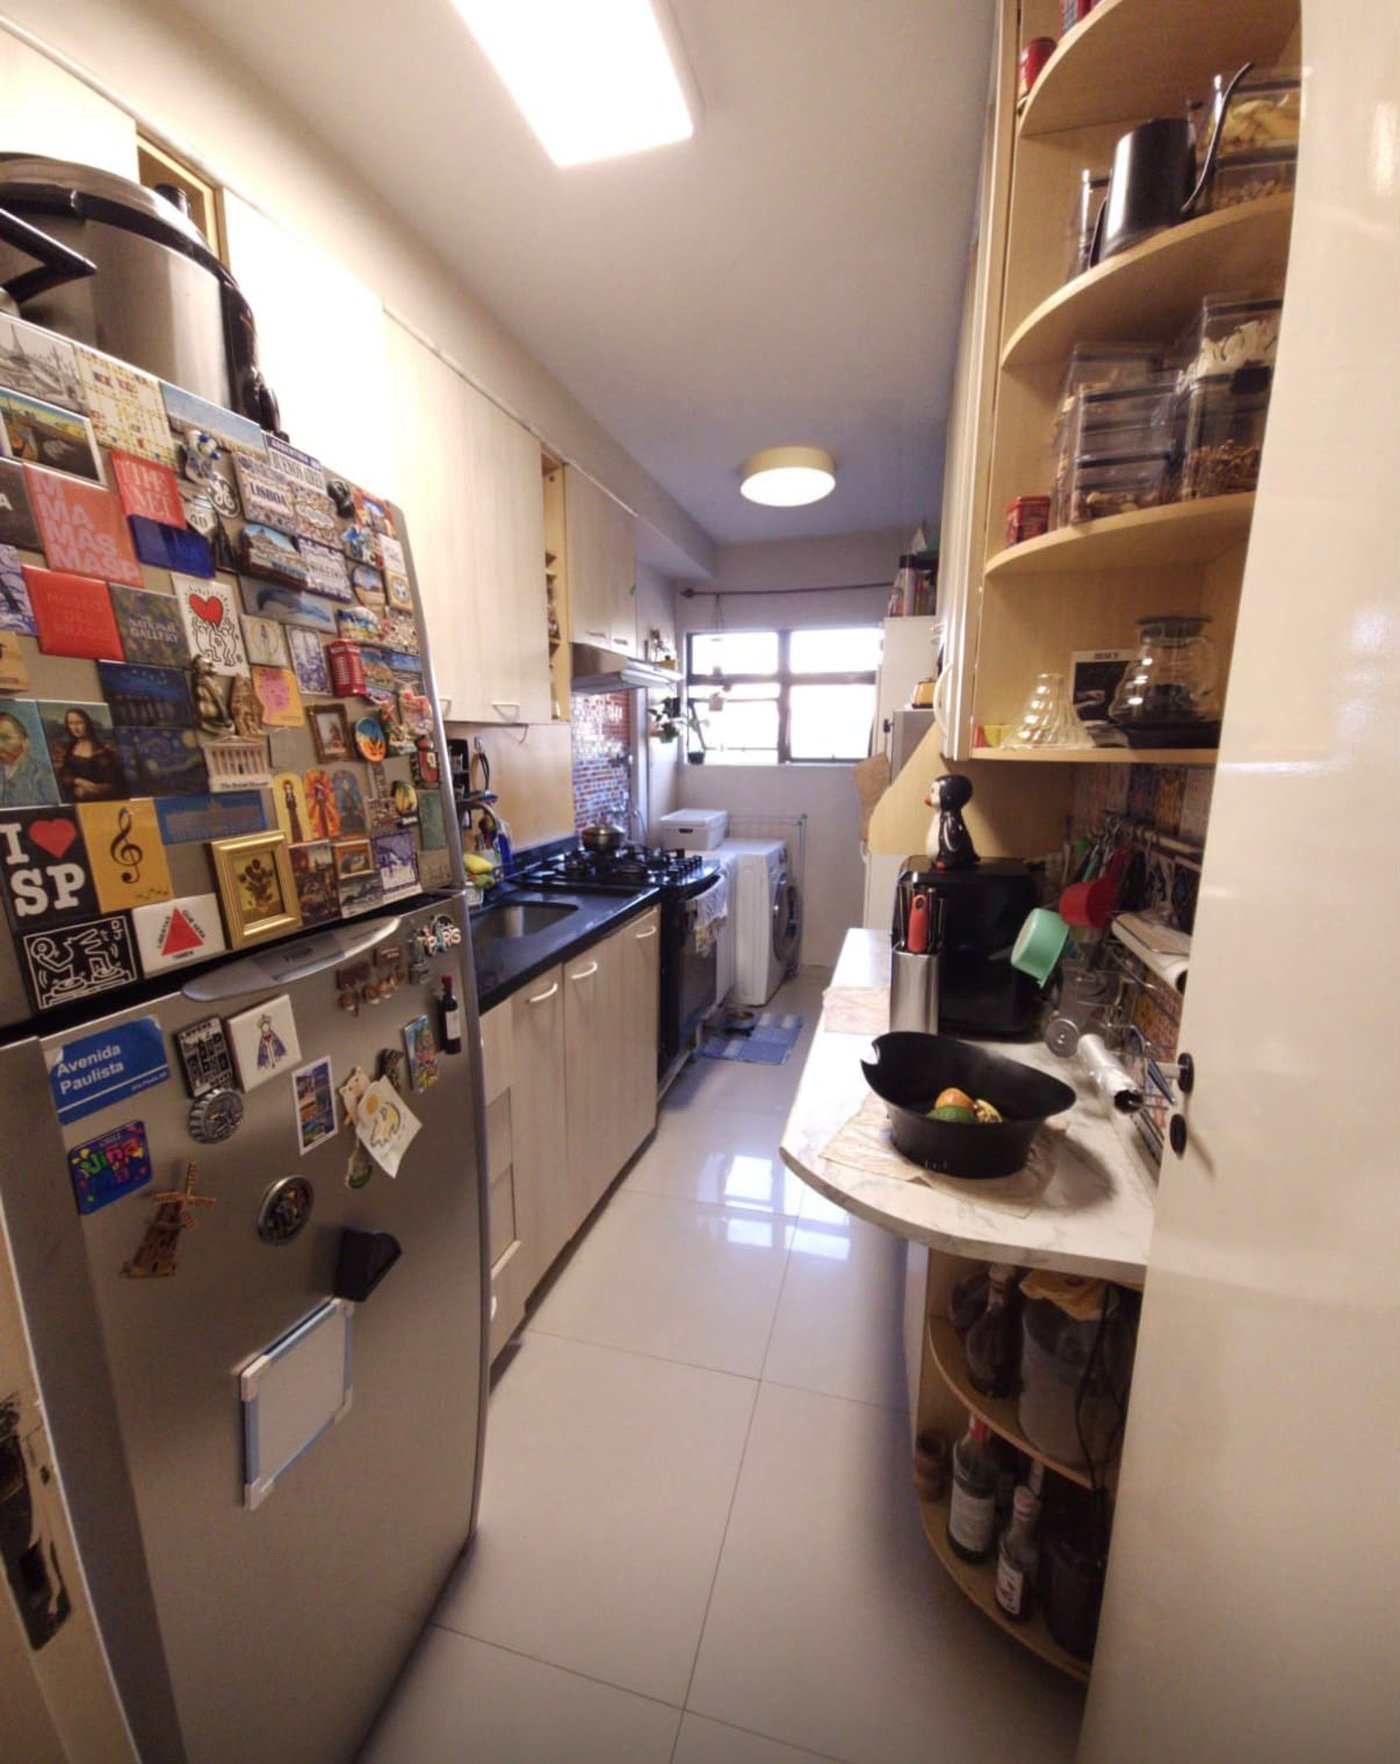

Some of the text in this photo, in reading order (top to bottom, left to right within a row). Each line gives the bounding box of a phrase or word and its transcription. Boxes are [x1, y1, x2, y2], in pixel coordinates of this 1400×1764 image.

[31, 467, 65, 500] M
[249, 481, 288, 507] LISBOA
[40, 495, 94, 530] MA
[43, 519, 117, 559] MAS
[49, 541, 141, 581] MASP
[0, 822, 30, 865] I
[10, 863, 85, 917] SP
[57, 1044, 122, 1077] Avenida
[59, 1061, 125, 1095] Paulista
